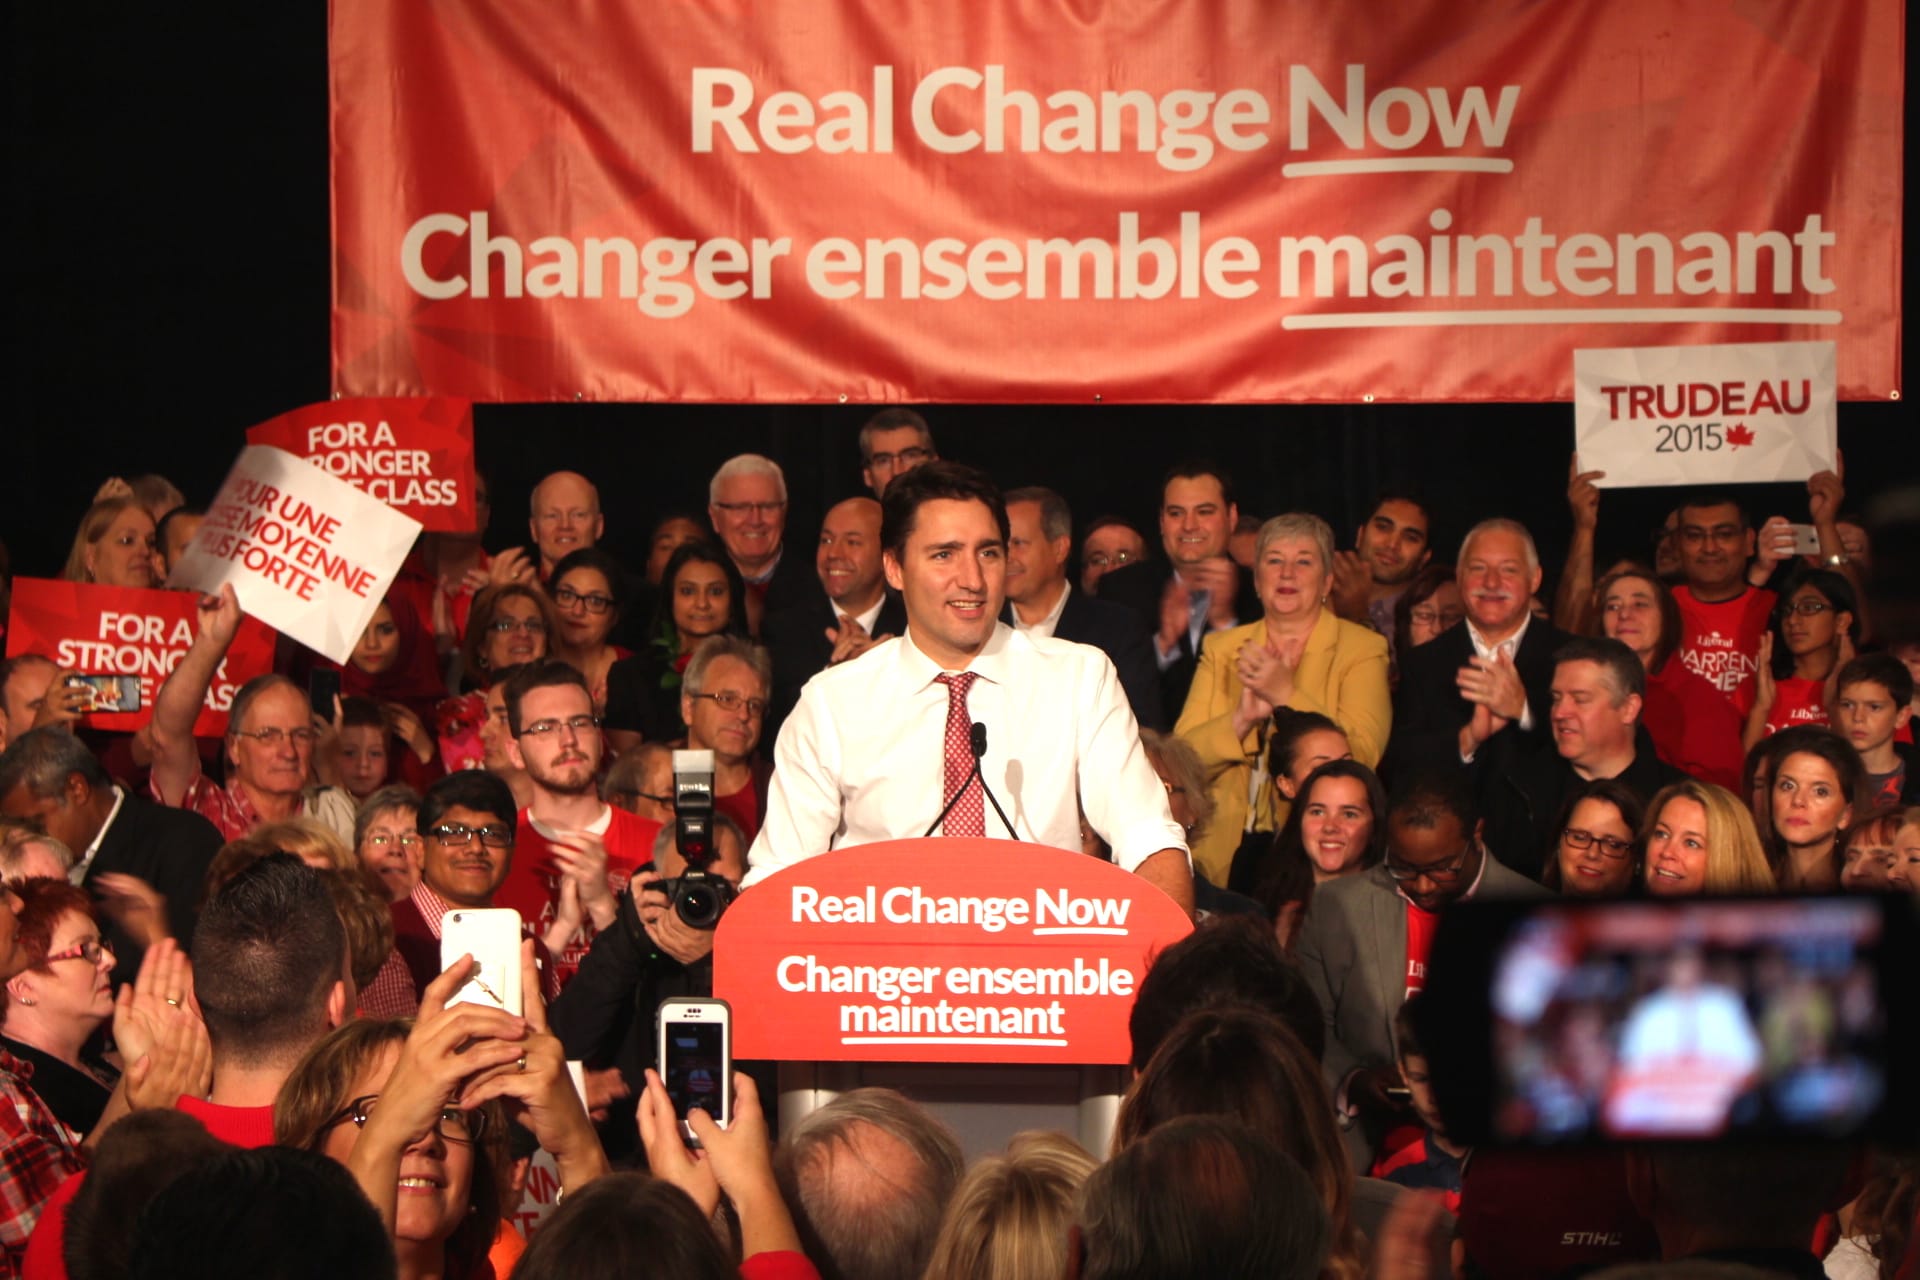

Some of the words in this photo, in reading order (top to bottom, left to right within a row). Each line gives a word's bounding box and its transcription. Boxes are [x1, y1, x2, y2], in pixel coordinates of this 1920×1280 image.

[691, 65, 893, 154] Real
[910, 65, 1270, 172] Change
[1290, 64, 1521, 151] Now
[400, 211, 791, 318] Changer
[805, 211, 1261, 300] ensemble
[1279, 208, 1837, 299] maintenant
[1601, 379, 1811, 420] TRUDEAU
[307, 421, 368, 452] FOR
[372, 421, 397, 447] A
[1655, 423, 1723, 452] 2015
[303, 449, 432, 477] ONGER
[368, 479, 458, 506] CLASS
[279, 495, 342, 544] UNE
[229, 535, 320, 602] FORTE
[237, 510, 376, 598] MOYENNE
[99, 611, 166, 644] FOR
[168, 618, 194, 647] A
[56, 639, 228, 680] STRONG
[1680, 649, 1760, 672] ARREN
[791, 886, 875, 922] Real
[881, 886, 1029, 933] Change
[1035, 888, 1131, 925] Now
[776, 955, 940, 1001] Changer
[946, 958, 1133, 996] ensemble
[840, 996, 1065, 1034] maintenant
[1561, 1231, 1621, 1246] STIHL
